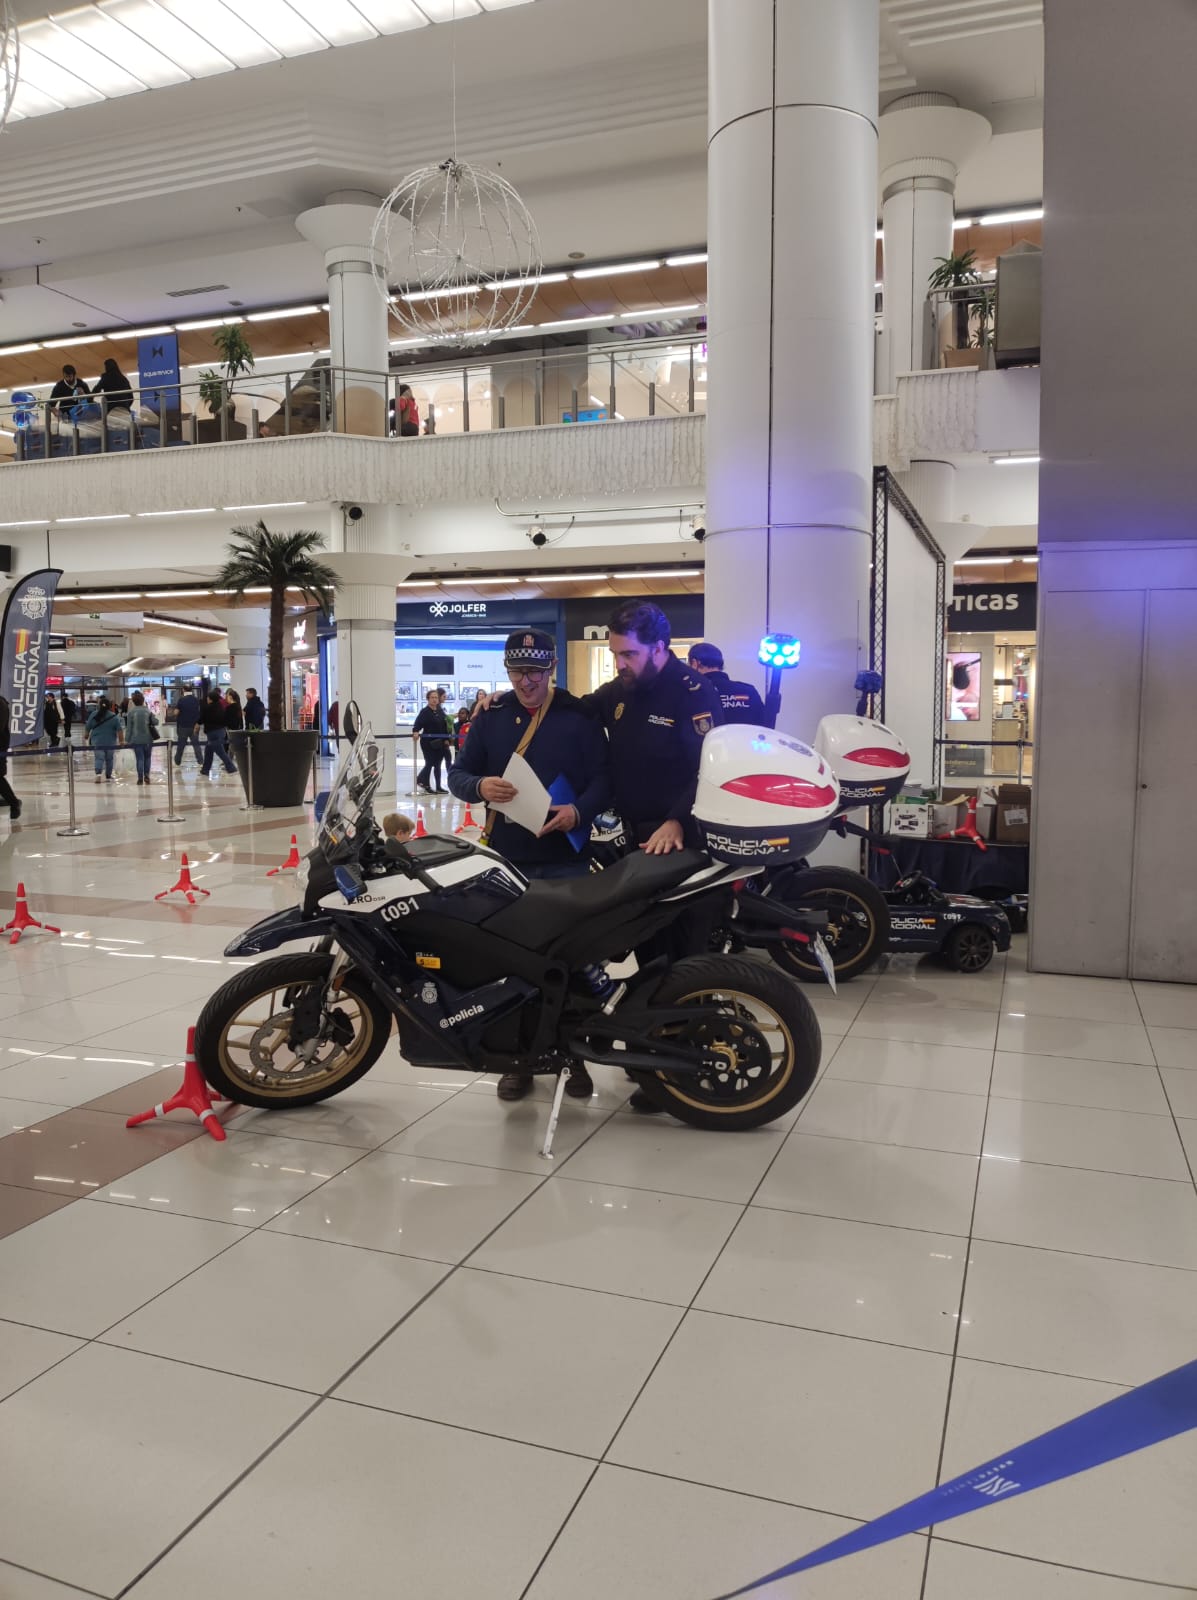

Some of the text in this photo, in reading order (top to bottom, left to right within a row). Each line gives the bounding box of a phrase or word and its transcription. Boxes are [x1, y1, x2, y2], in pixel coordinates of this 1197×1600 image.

[448, 603, 487, 613] JOLFER
[10, 650, 28, 734] POLICIA
[23, 630, 43, 735] NACIONAL
[705, 832, 770, 847] POLICIA
[439, 1004, 485, 1029] @policia
